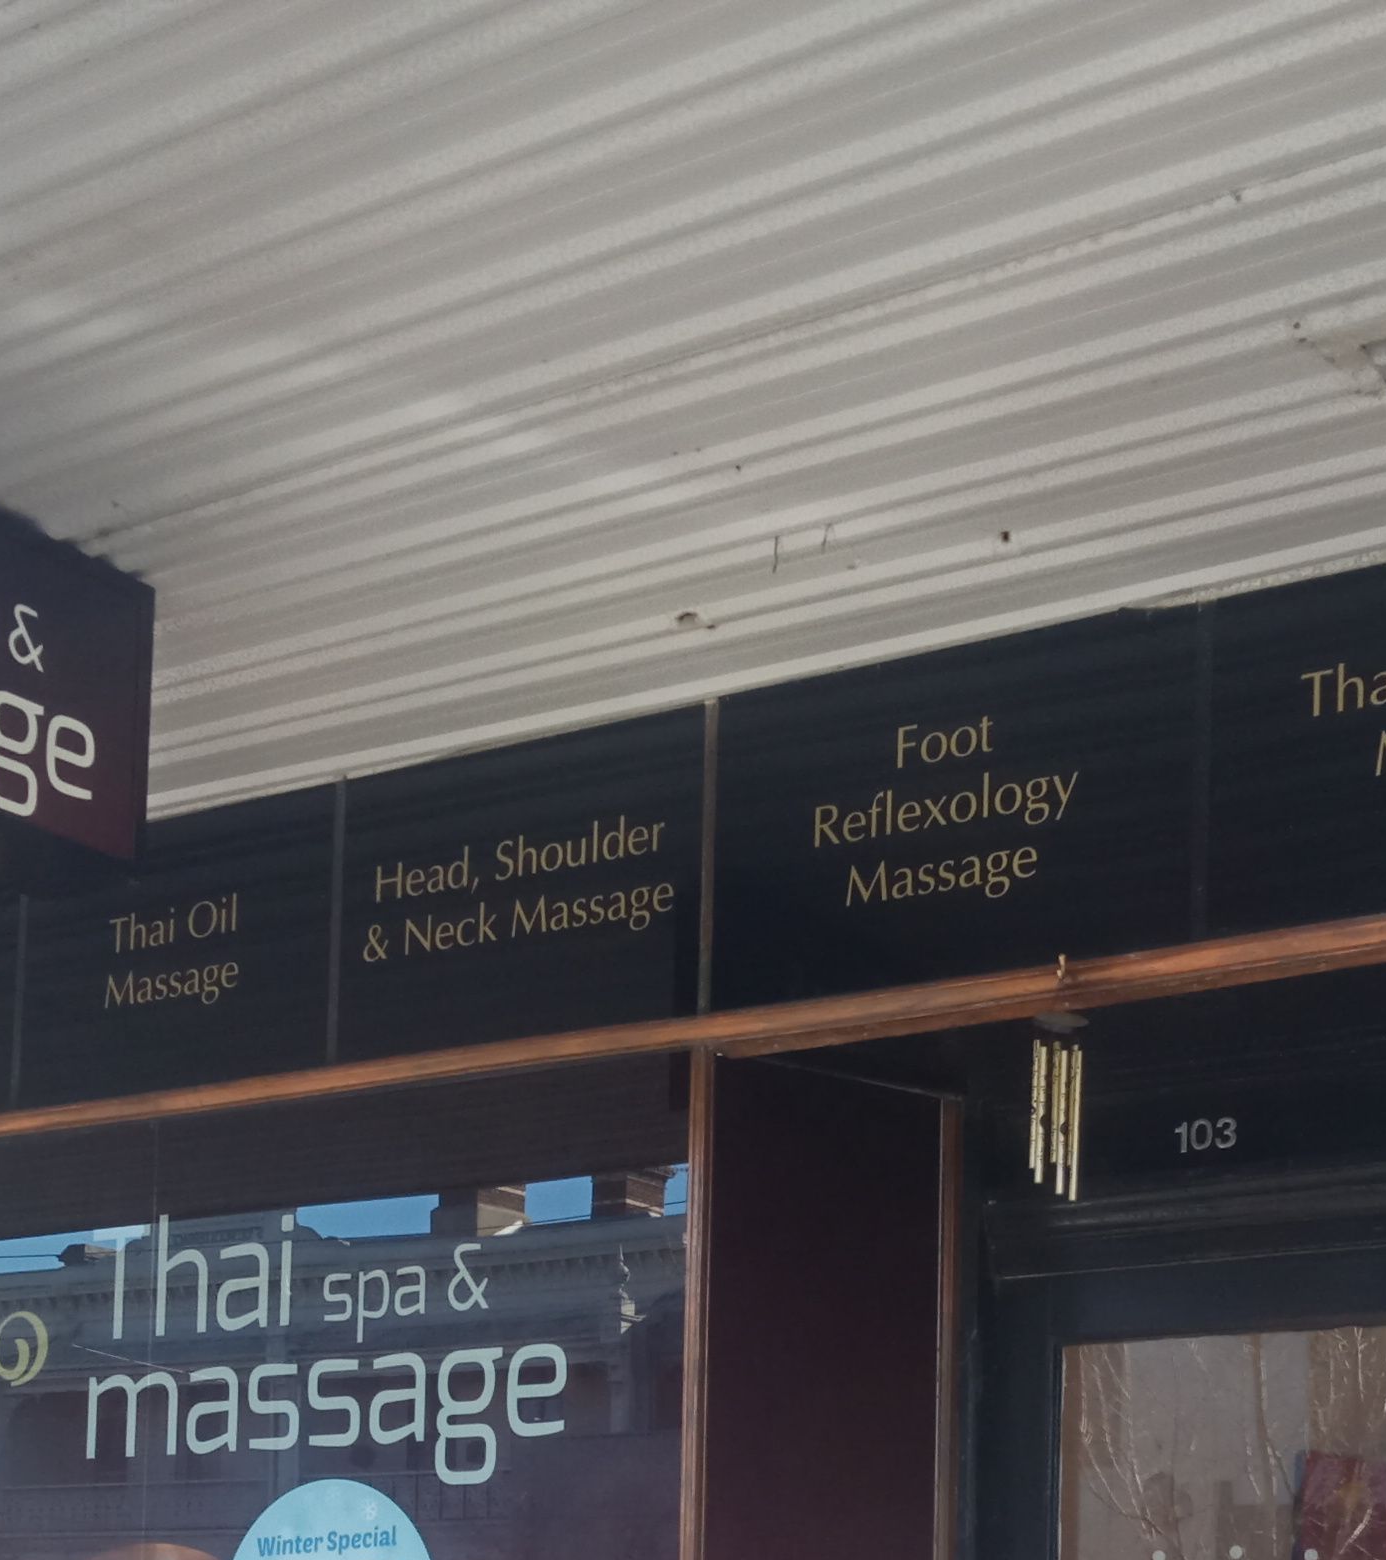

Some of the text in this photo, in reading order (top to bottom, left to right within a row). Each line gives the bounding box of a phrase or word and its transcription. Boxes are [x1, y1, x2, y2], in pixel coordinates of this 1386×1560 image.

[8, 603, 44, 673] &
[896, 715, 994, 769] Foot
[814, 771, 1079, 848] Reflexology
[375, 815, 665, 903] Head, Shoulder
[845, 844, 1038, 907] Massage
[109, 892, 238, 954] Thai Oil
[363, 881, 675, 962] & Neck Massage
[103, 959, 239, 1009] Massage
[1174, 1116, 1237, 1154] 103
[93, 1214, 489, 1343] Thai spa &
[85, 1342, 568, 1485] massage
[257, 1525, 397, 1557] Winter Special
